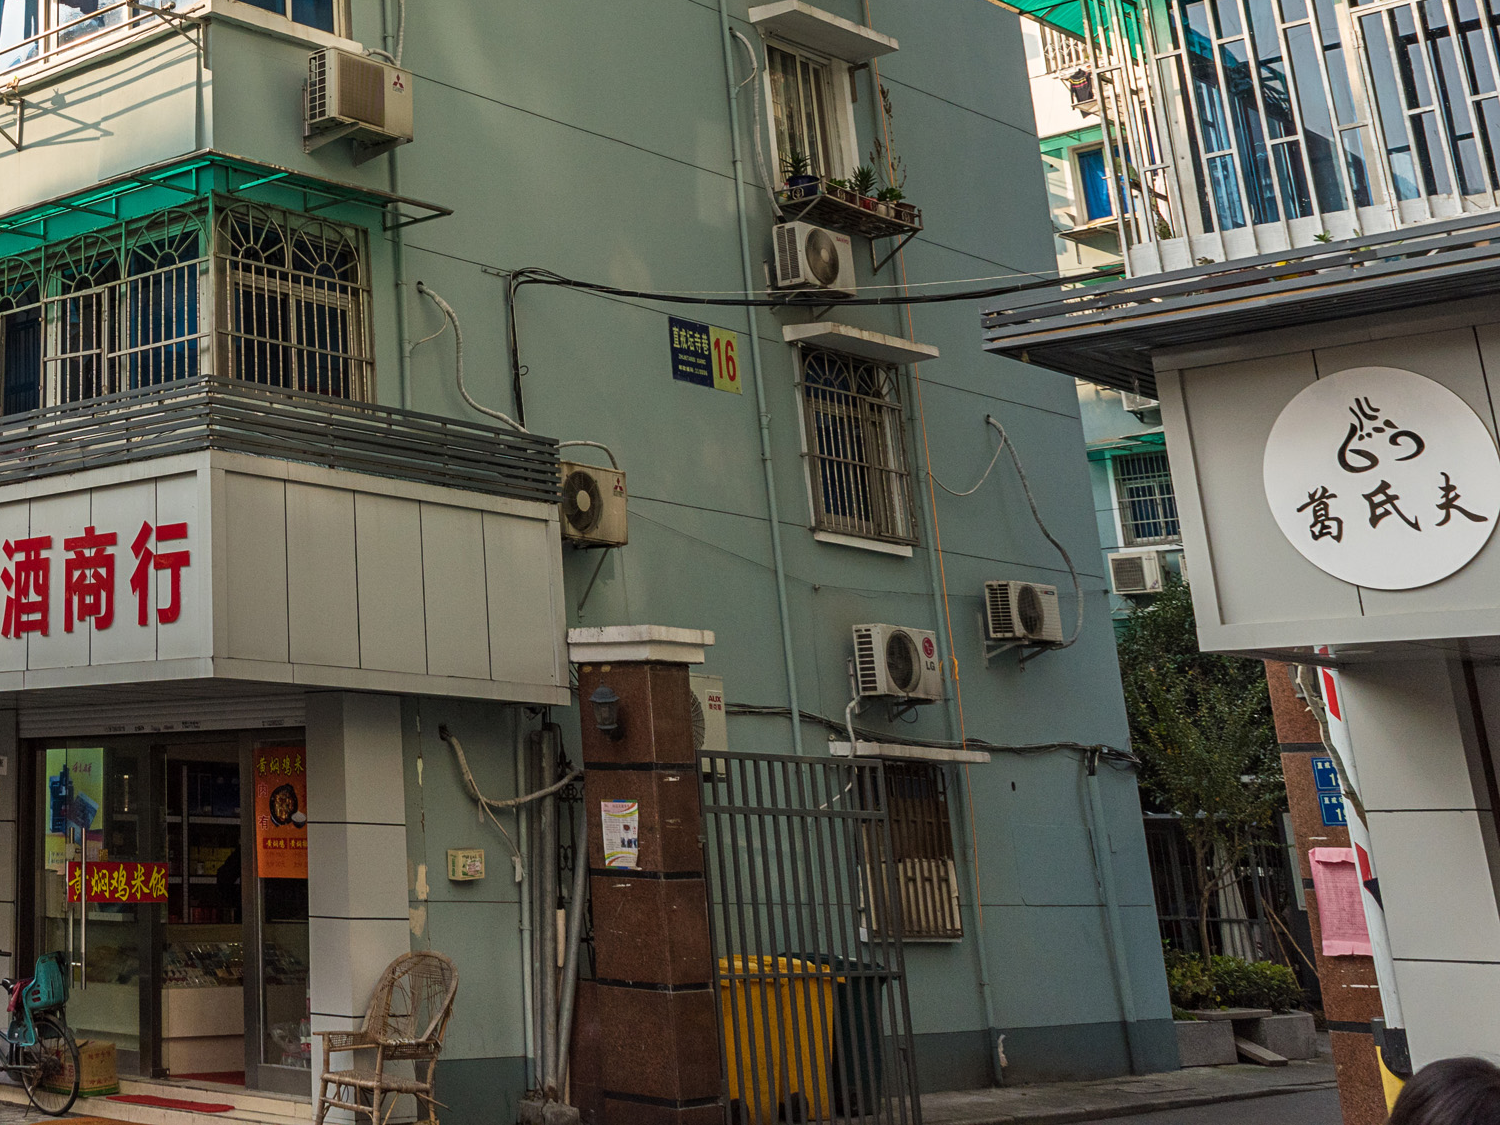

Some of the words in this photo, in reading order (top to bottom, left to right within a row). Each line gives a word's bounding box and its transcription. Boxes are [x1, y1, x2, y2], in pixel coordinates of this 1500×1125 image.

[714, 337, 737, 383] 16
[925, 660, 936, 672] LG
[707, 695, 722, 703] AUX
[256, 754, 304, 776] 黄焖鸡米
[68, 863, 169, 902] 黄焖鸡米饭
